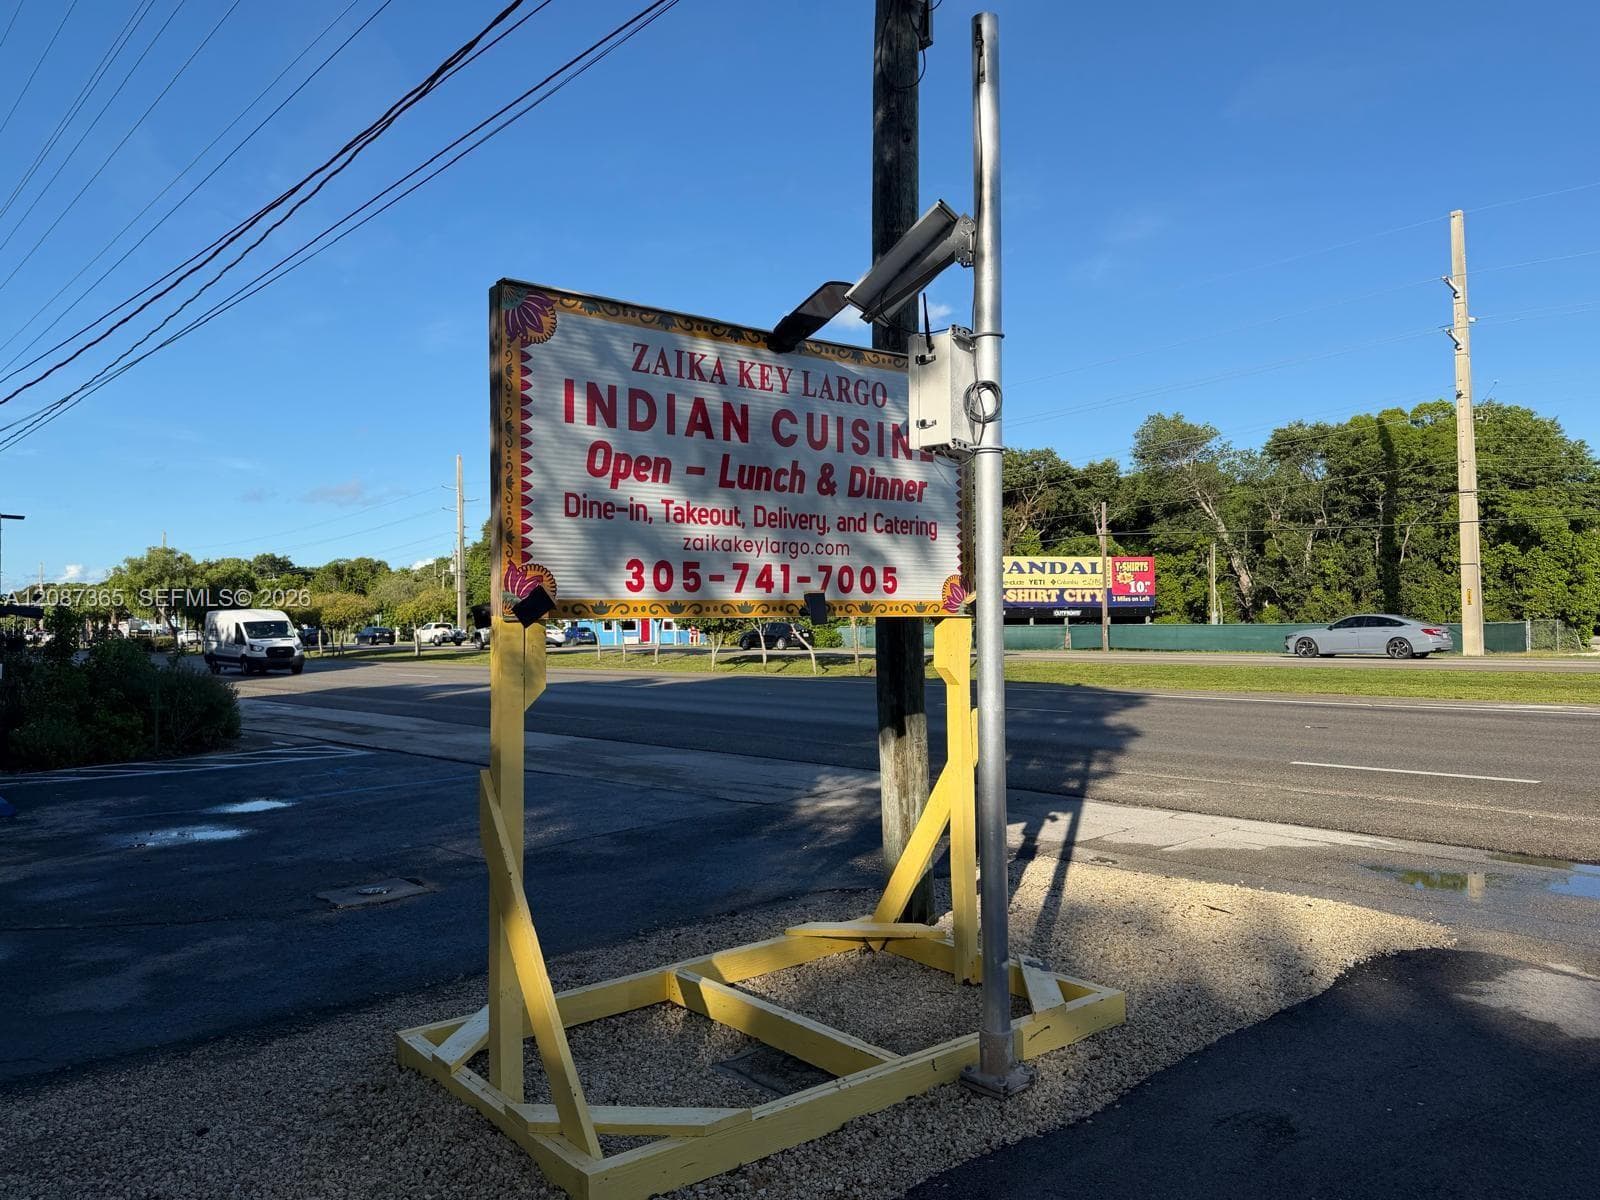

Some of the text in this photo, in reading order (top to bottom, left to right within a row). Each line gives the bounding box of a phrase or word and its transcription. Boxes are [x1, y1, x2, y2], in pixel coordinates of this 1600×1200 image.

[631, 342, 888, 409] ZAIKA KEY LARGO
[564, 378, 934, 463] INDIAN CUISIN
[586, 440, 672, 490] Open
[719, 453, 806, 494] Lunch
[816, 462, 838, 497] &
[847, 465, 928, 503] Dinner
[564, 492, 938, 541] Dine-in, Takeout, Delivery, and Catering
[683, 534, 850, 559] zaikakeylargo.com
[1003, 561, 1102, 574] ANDAL
[1114, 561, 1149, 572] T-SHIRTS
[625, 558, 898, 595] 305-741-7005
